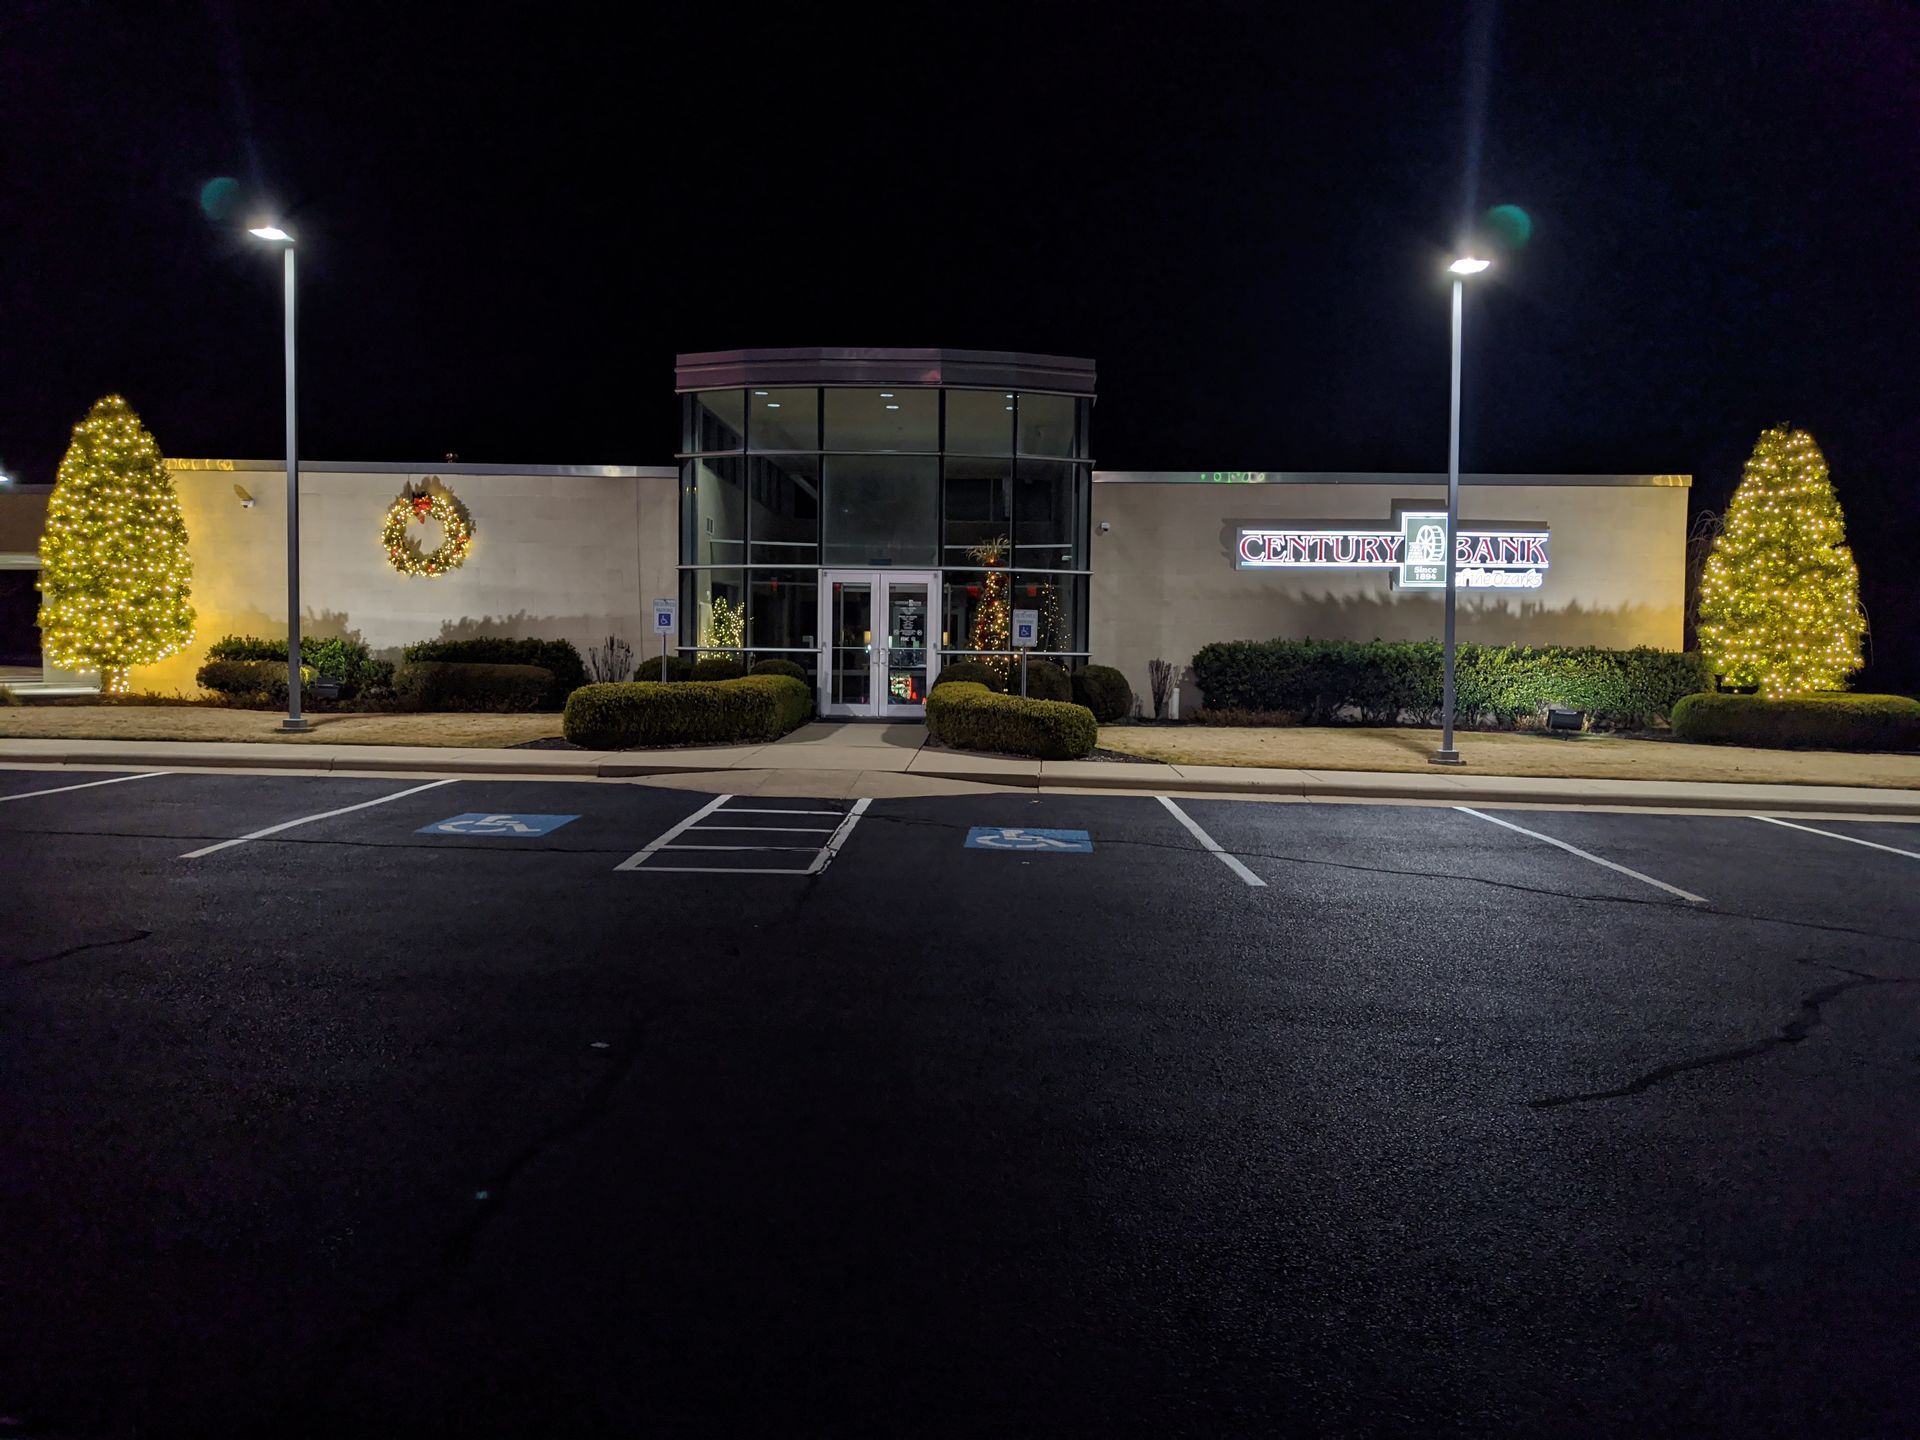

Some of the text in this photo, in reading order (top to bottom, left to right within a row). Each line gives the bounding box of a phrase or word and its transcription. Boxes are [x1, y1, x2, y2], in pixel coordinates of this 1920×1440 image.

[1239, 534, 1549, 564] CENTURY BANK
[1414, 566, 1438, 574] Since
[1492, 568, 1543, 588] Ozarks
